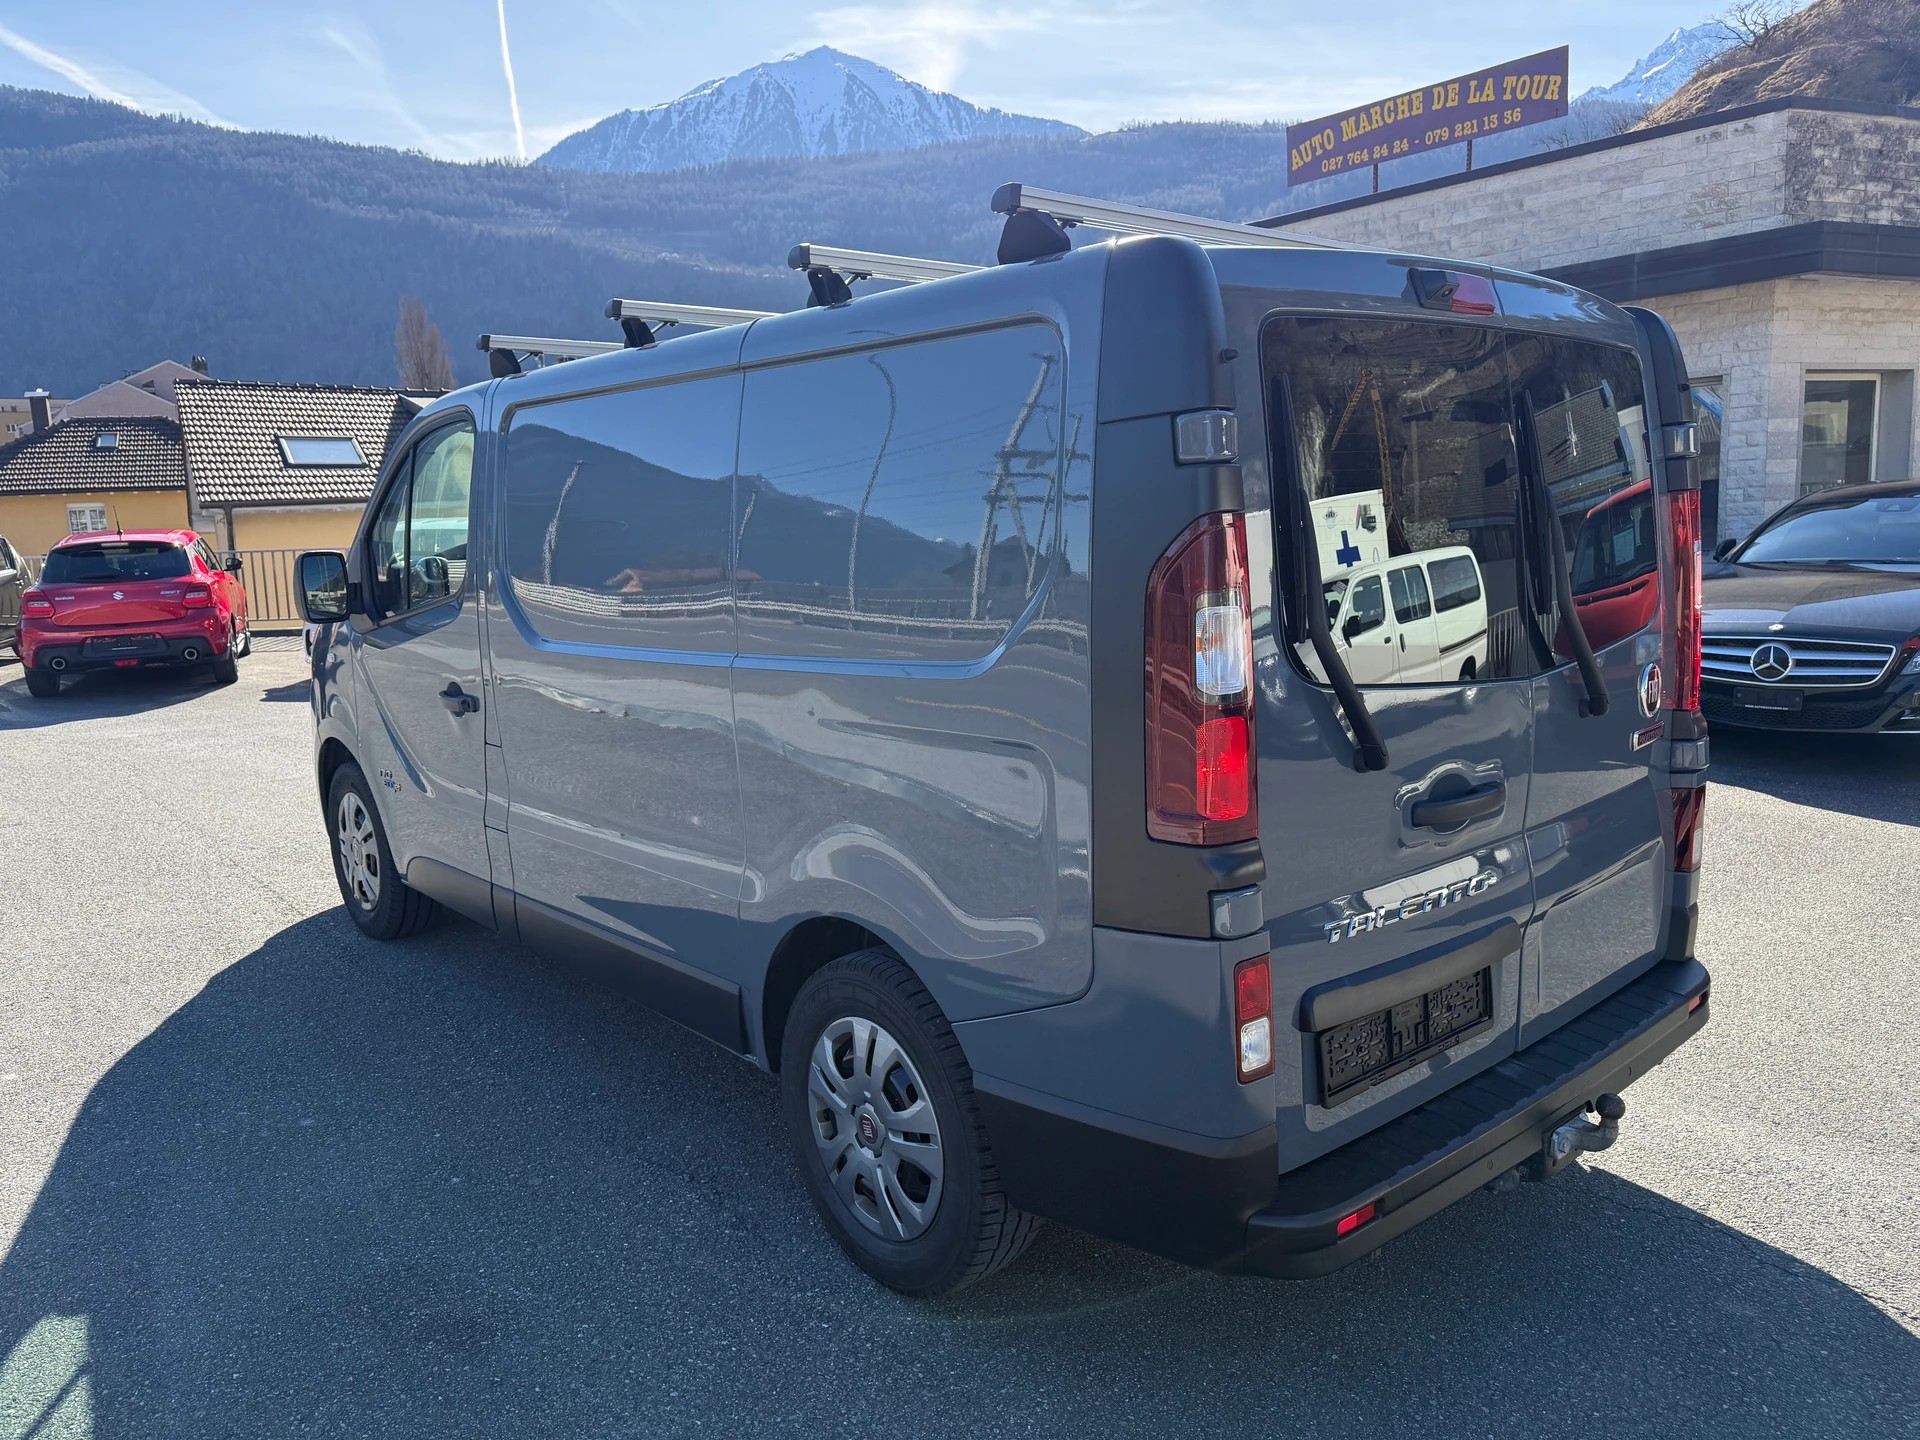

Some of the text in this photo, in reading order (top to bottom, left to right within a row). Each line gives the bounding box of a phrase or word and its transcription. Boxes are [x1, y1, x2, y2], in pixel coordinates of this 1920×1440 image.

[1290, 75, 1562, 171] AUTO MARCHE DE LA TOUR
[1321, 157, 1343, 173] 027
[1347, 149, 1369, 164] 764
[1373, 144, 1389, 158] 24
[1393, 137, 1409, 152] 24
[1425, 127, 1449, 145] 079
[1454, 121, 1478, 137] 221
[1483, 113, 1498, 129] 13
[1504, 107, 1522, 125] 36
[1323, 869, 1500, 944] TALENTO
[862, 1120, 874, 1139] FIAT
